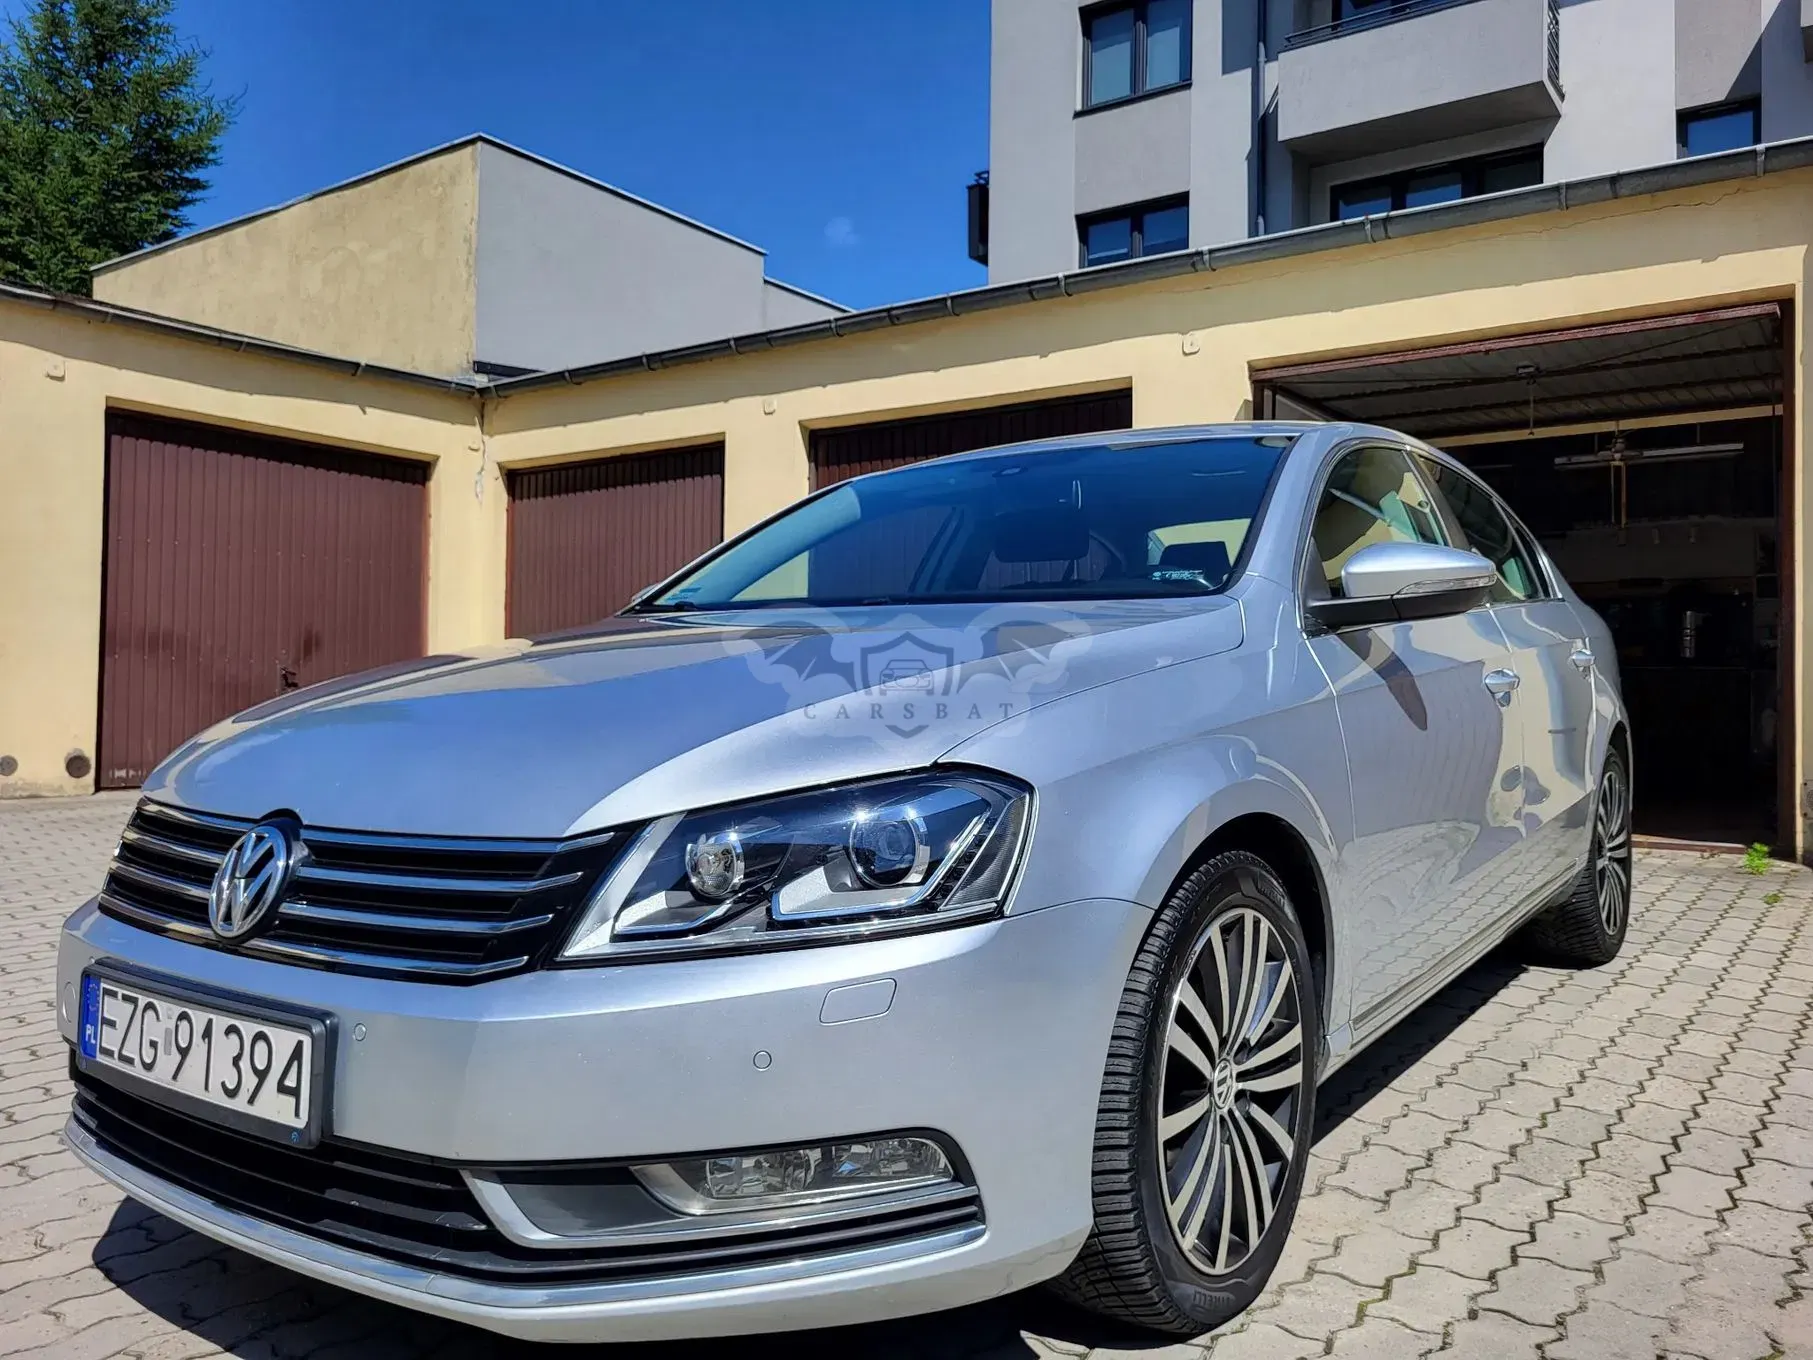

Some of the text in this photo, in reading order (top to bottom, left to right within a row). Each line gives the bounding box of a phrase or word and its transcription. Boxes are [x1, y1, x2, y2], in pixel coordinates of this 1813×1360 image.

[85, 1024, 97, 1045] PL
[98, 986, 306, 1119] EZG 91394
